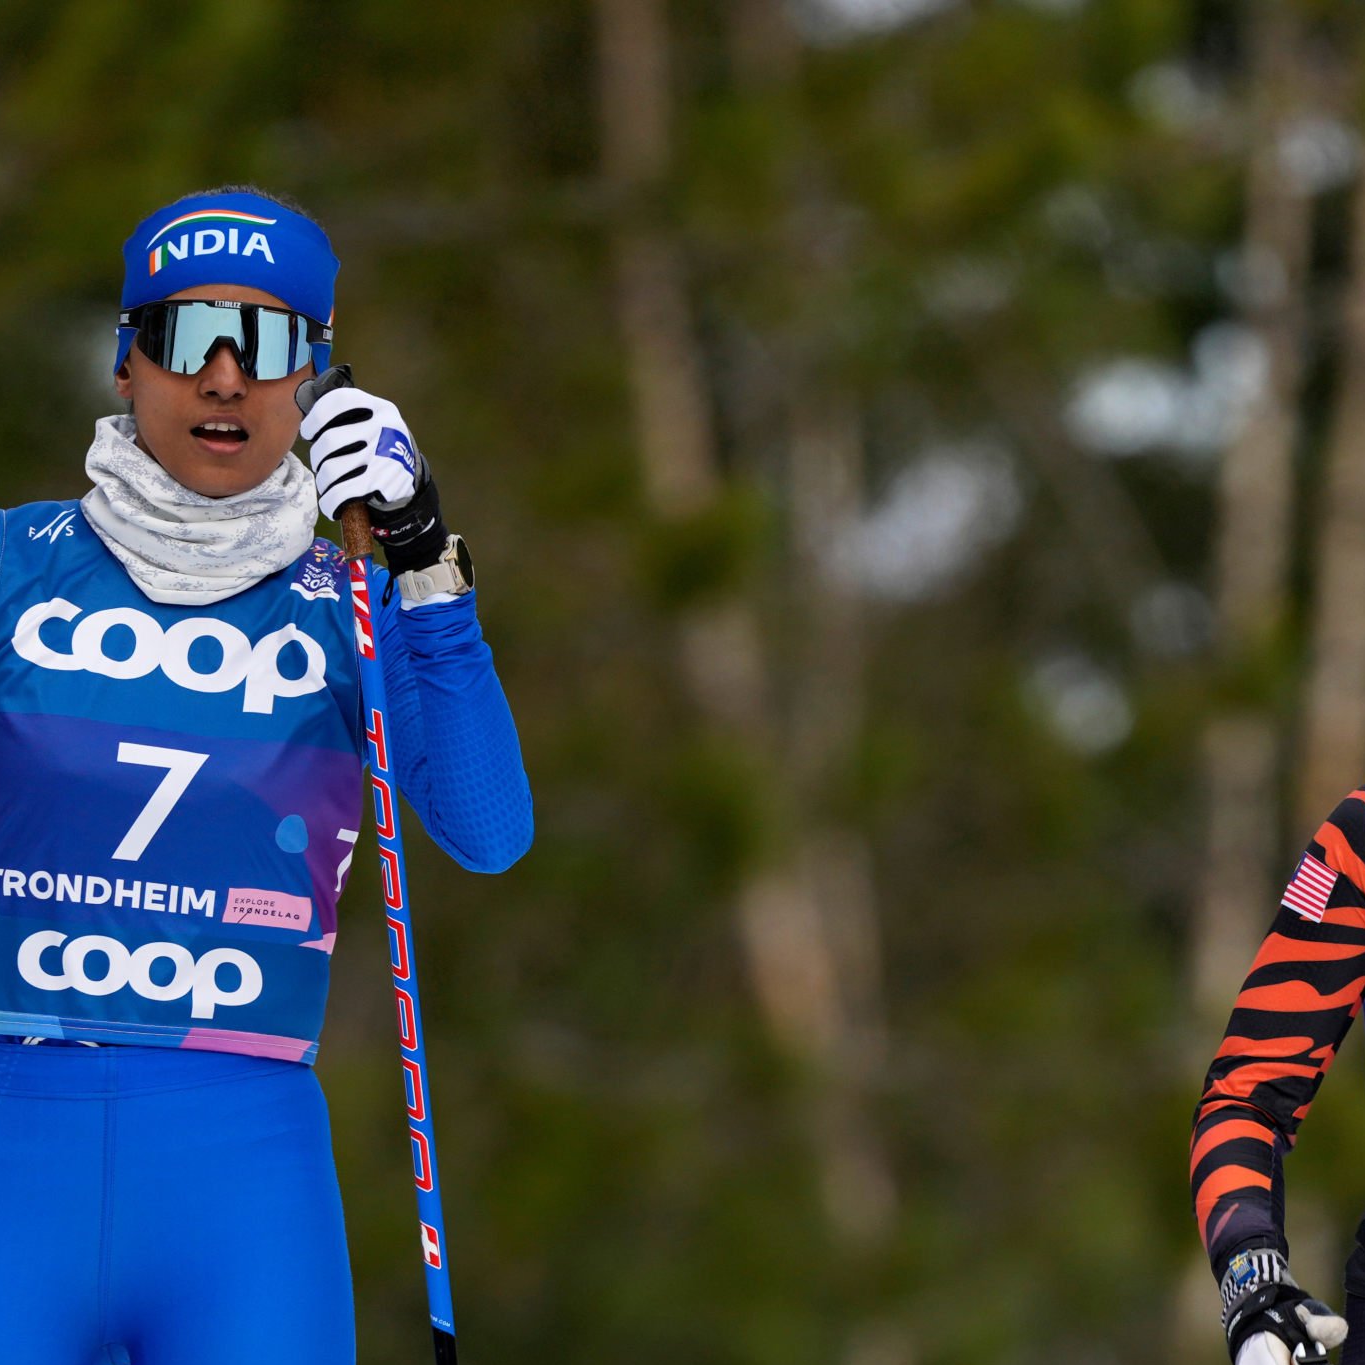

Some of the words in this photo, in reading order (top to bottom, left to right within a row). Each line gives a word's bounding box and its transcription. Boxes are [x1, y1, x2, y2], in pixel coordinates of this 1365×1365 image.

[149, 228, 275, 277] INDIA
[11, 597, 327, 714] coop
[113, 742, 209, 862] 7
[234, 897, 275, 908] EXPLORE
[17, 930, 264, 1019] coop
